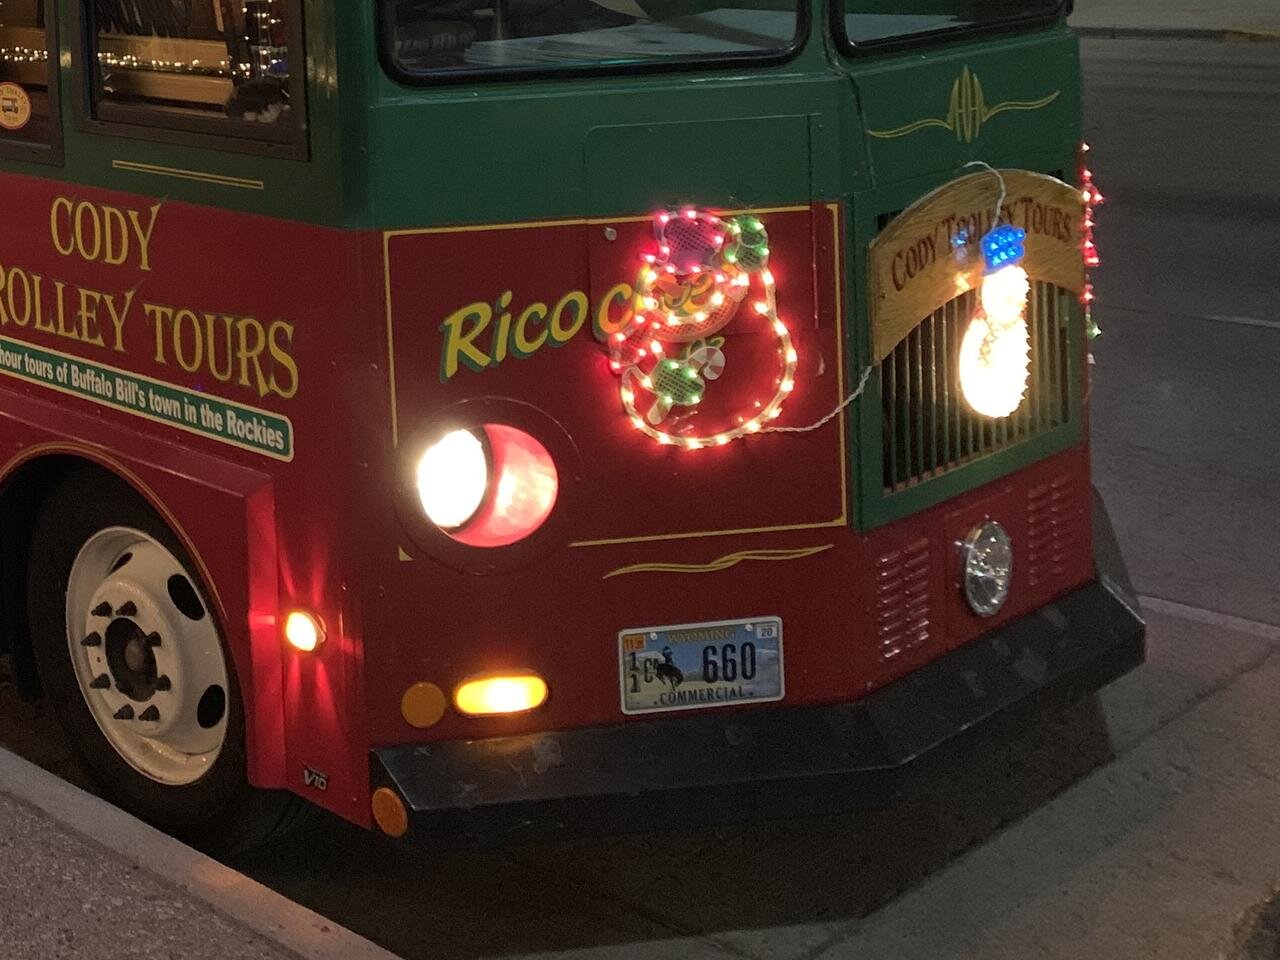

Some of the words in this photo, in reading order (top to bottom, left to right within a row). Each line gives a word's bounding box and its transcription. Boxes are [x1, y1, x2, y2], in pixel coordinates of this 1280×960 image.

[50, 195, 166, 271] CODY
[891, 223, 938, 291] CODY
[1021, 196, 1072, 243] TOURS
[144, 302, 300, 399] TOURS
[24, 352, 54, 381] tours
[57, 362, 69, 383] of
[71, 363, 113, 401] Buffalo
[116, 378, 146, 409] Bill's
[148, 394, 181, 421] town
[184, 399, 197, 424] in
[200, 403, 223, 432] the
[227, 410, 285, 450] Rockies
[659, 685, 745, 706] COMMERCIAL
[702, 642, 756, 684] 660
